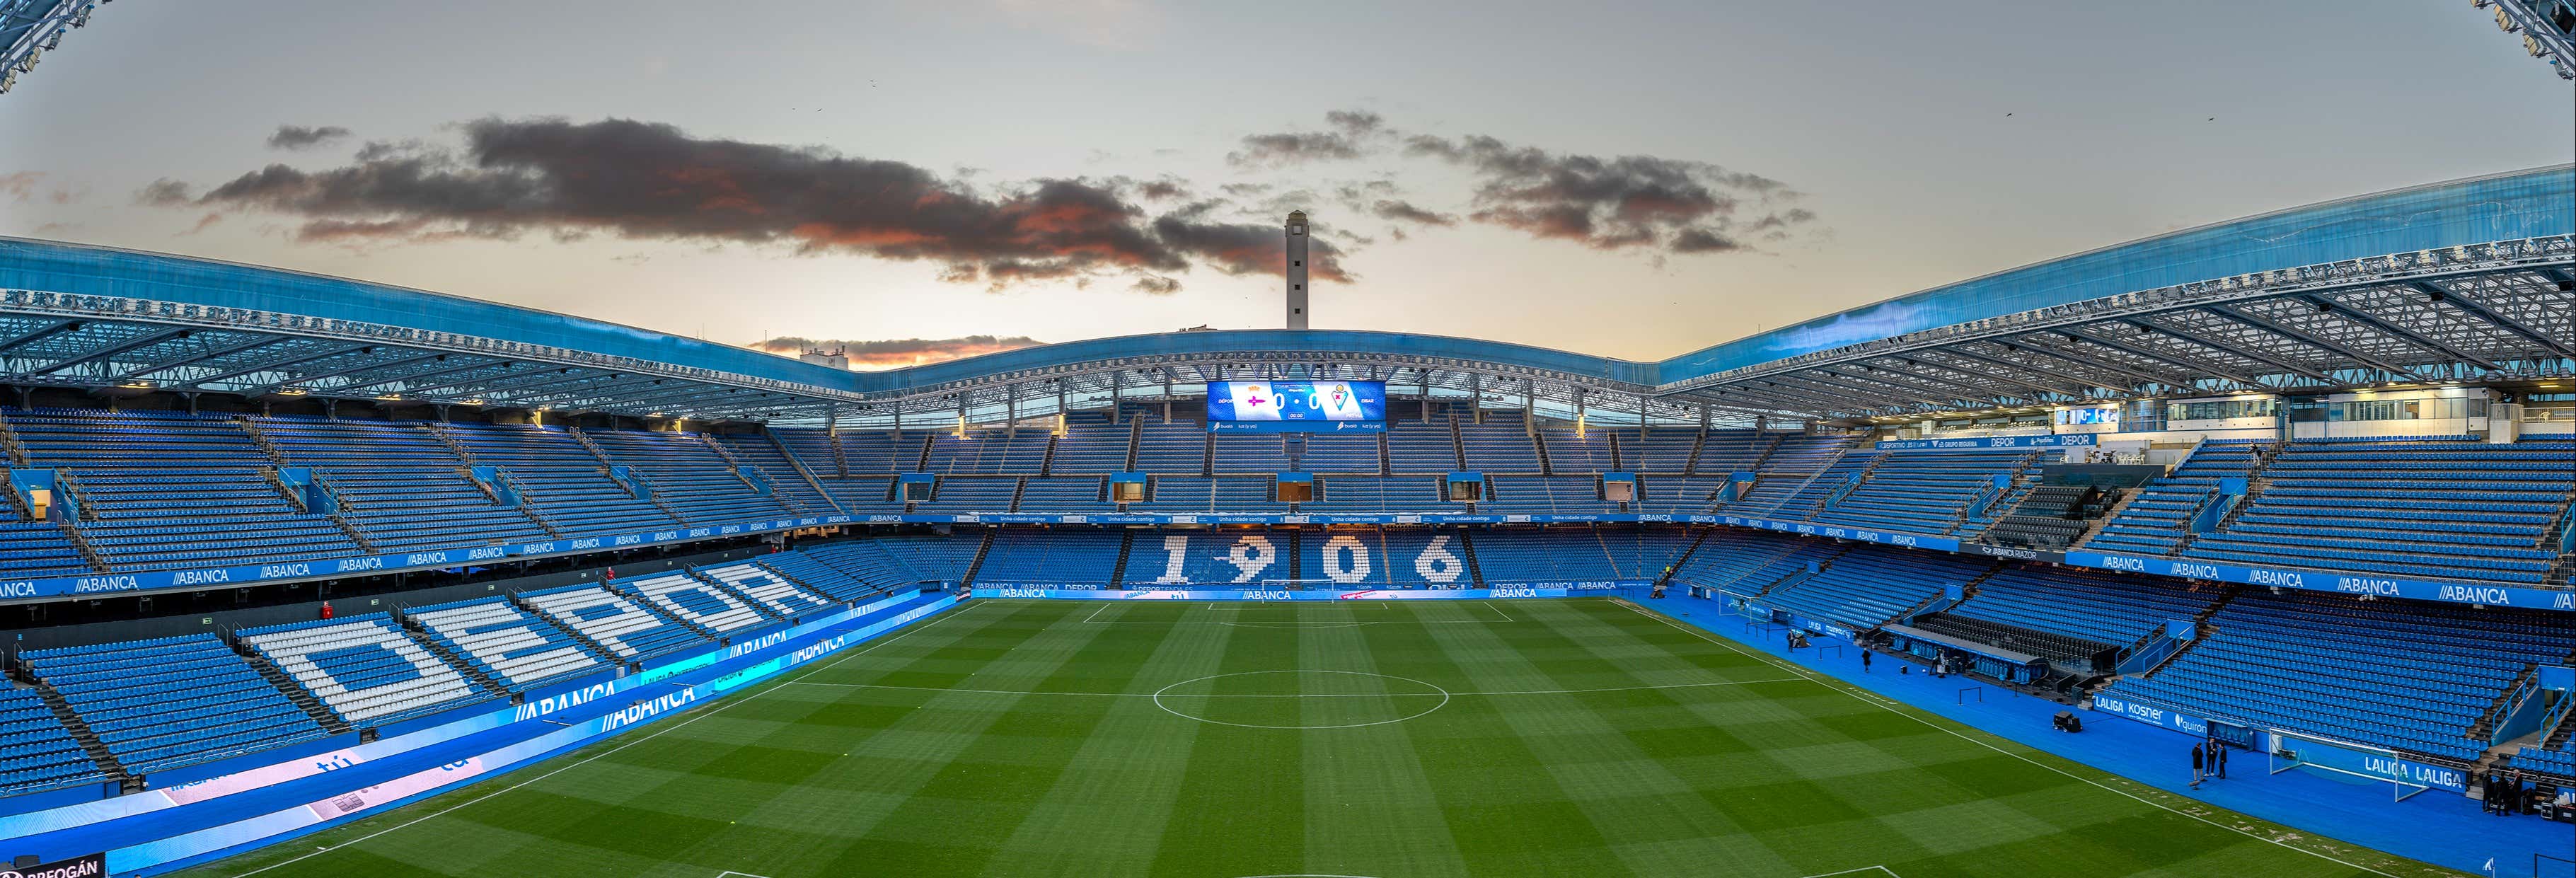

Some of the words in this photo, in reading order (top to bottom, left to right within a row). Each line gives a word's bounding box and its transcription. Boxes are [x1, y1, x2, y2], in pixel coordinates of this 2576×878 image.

[1991, 438, 2016, 447] DEPOR
[2061, 435, 2090, 446] DEPOR
[2015, 548, 2038, 560] RIAZOR
[2096, 695, 2124, 713] LALIGA
[2364, 756, 2408, 778] LALIGA
[2415, 766, 2462, 789] LALIGA
